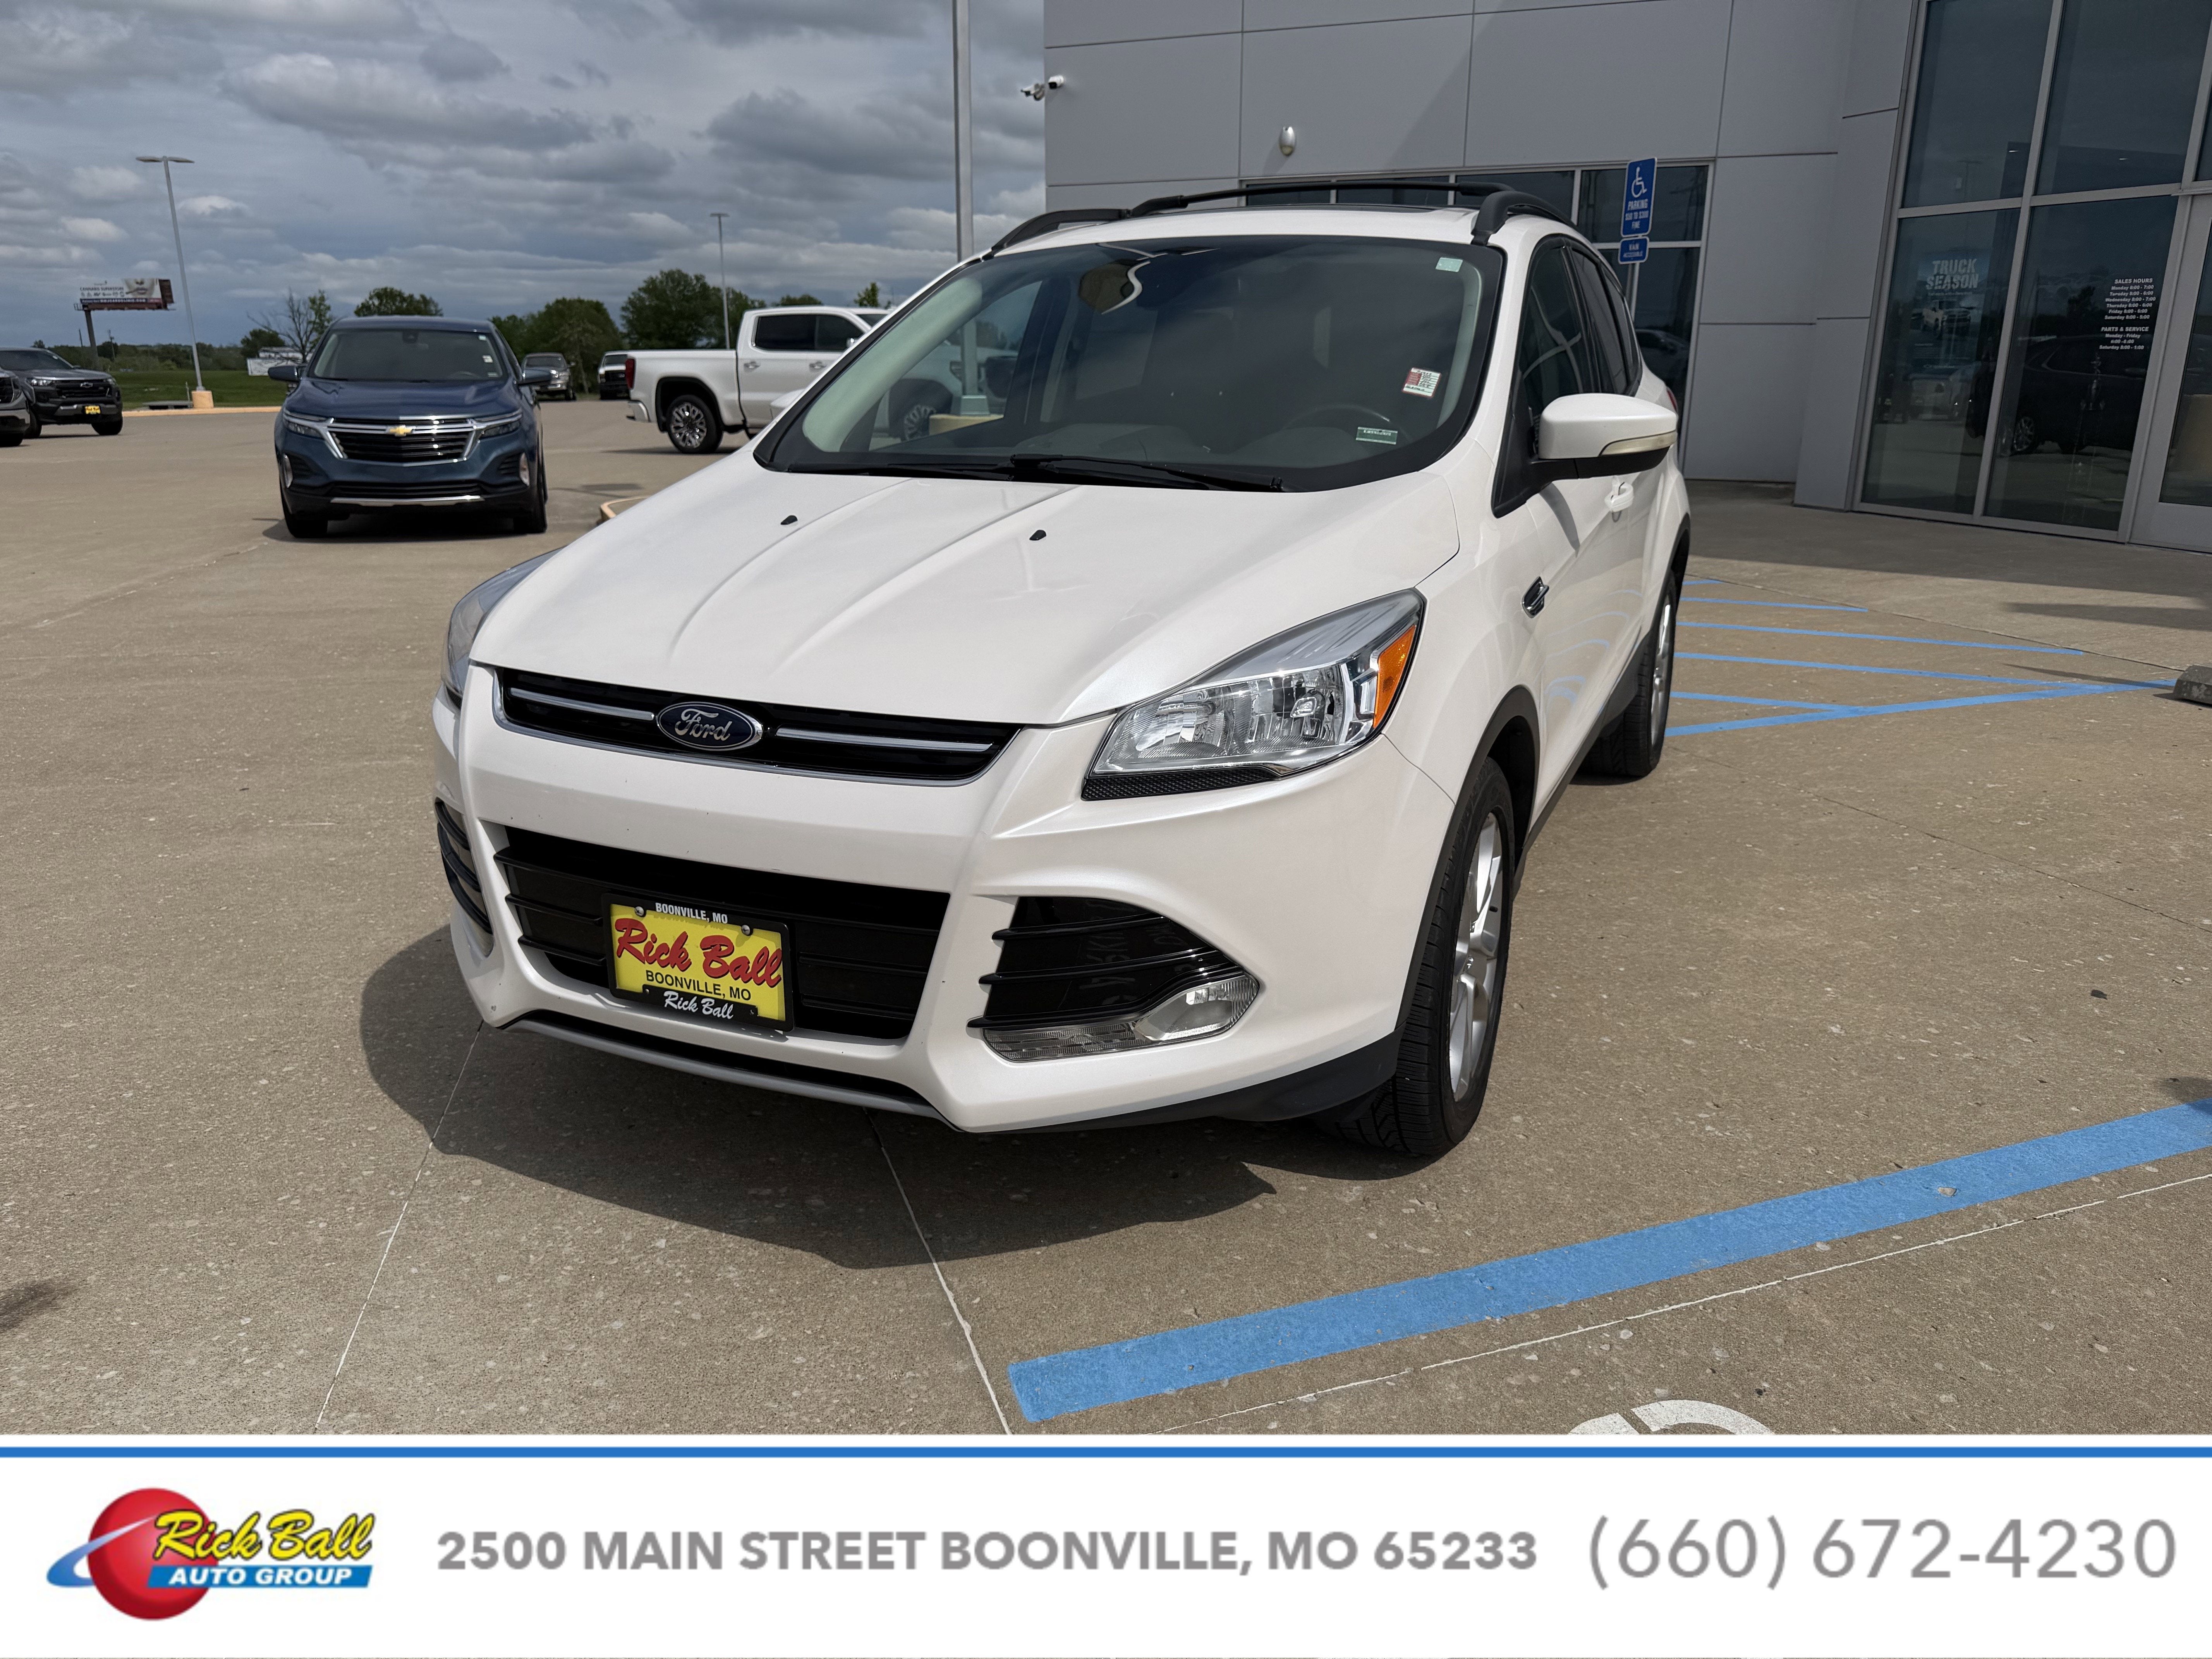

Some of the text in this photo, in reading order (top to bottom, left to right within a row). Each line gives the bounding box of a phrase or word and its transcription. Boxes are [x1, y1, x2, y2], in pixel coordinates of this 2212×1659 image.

[1628, 199, 1649, 211] PARKING
[1932, 258, 1977, 274] TRUCK
[1926, 273, 1979, 290] SEASON
[675, 708, 732, 741] Ford
[655, 902, 728, 924] BOONVILLE, MO
[615, 918, 783, 988] Rick Ball
[646, 970, 751, 1001] BOONVILLE, MO
[663, 991, 734, 1020] Rick Ball
